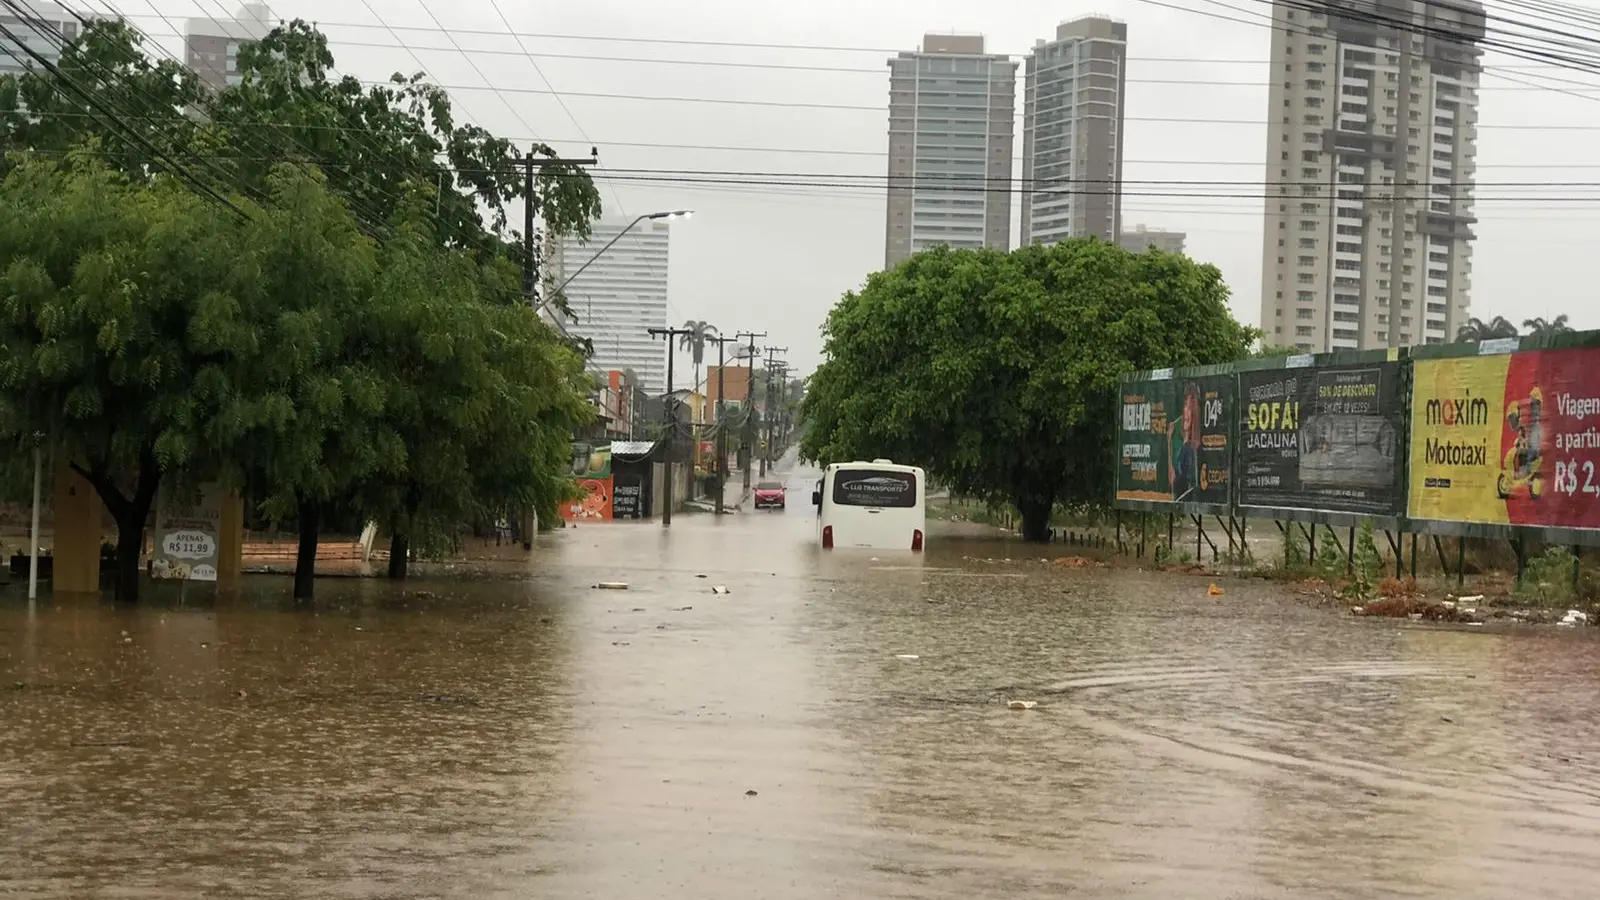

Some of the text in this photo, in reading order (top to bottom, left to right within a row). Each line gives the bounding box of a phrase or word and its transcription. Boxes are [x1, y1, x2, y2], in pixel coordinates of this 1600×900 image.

[1333, 385, 1342, 397] DE
[1343, 383, 1377, 397] DESCONTO
[1248, 395, 1299, 431] SOFÁ!
[1426, 388, 1488, 425] maxim
[1425, 437, 1487, 466] Mototaxi
[1556, 433, 1562, 449] a
[1554, 457, 1578, 497] R$
[169, 542, 180, 552] R$
[176, 534, 205, 542] APENAS
